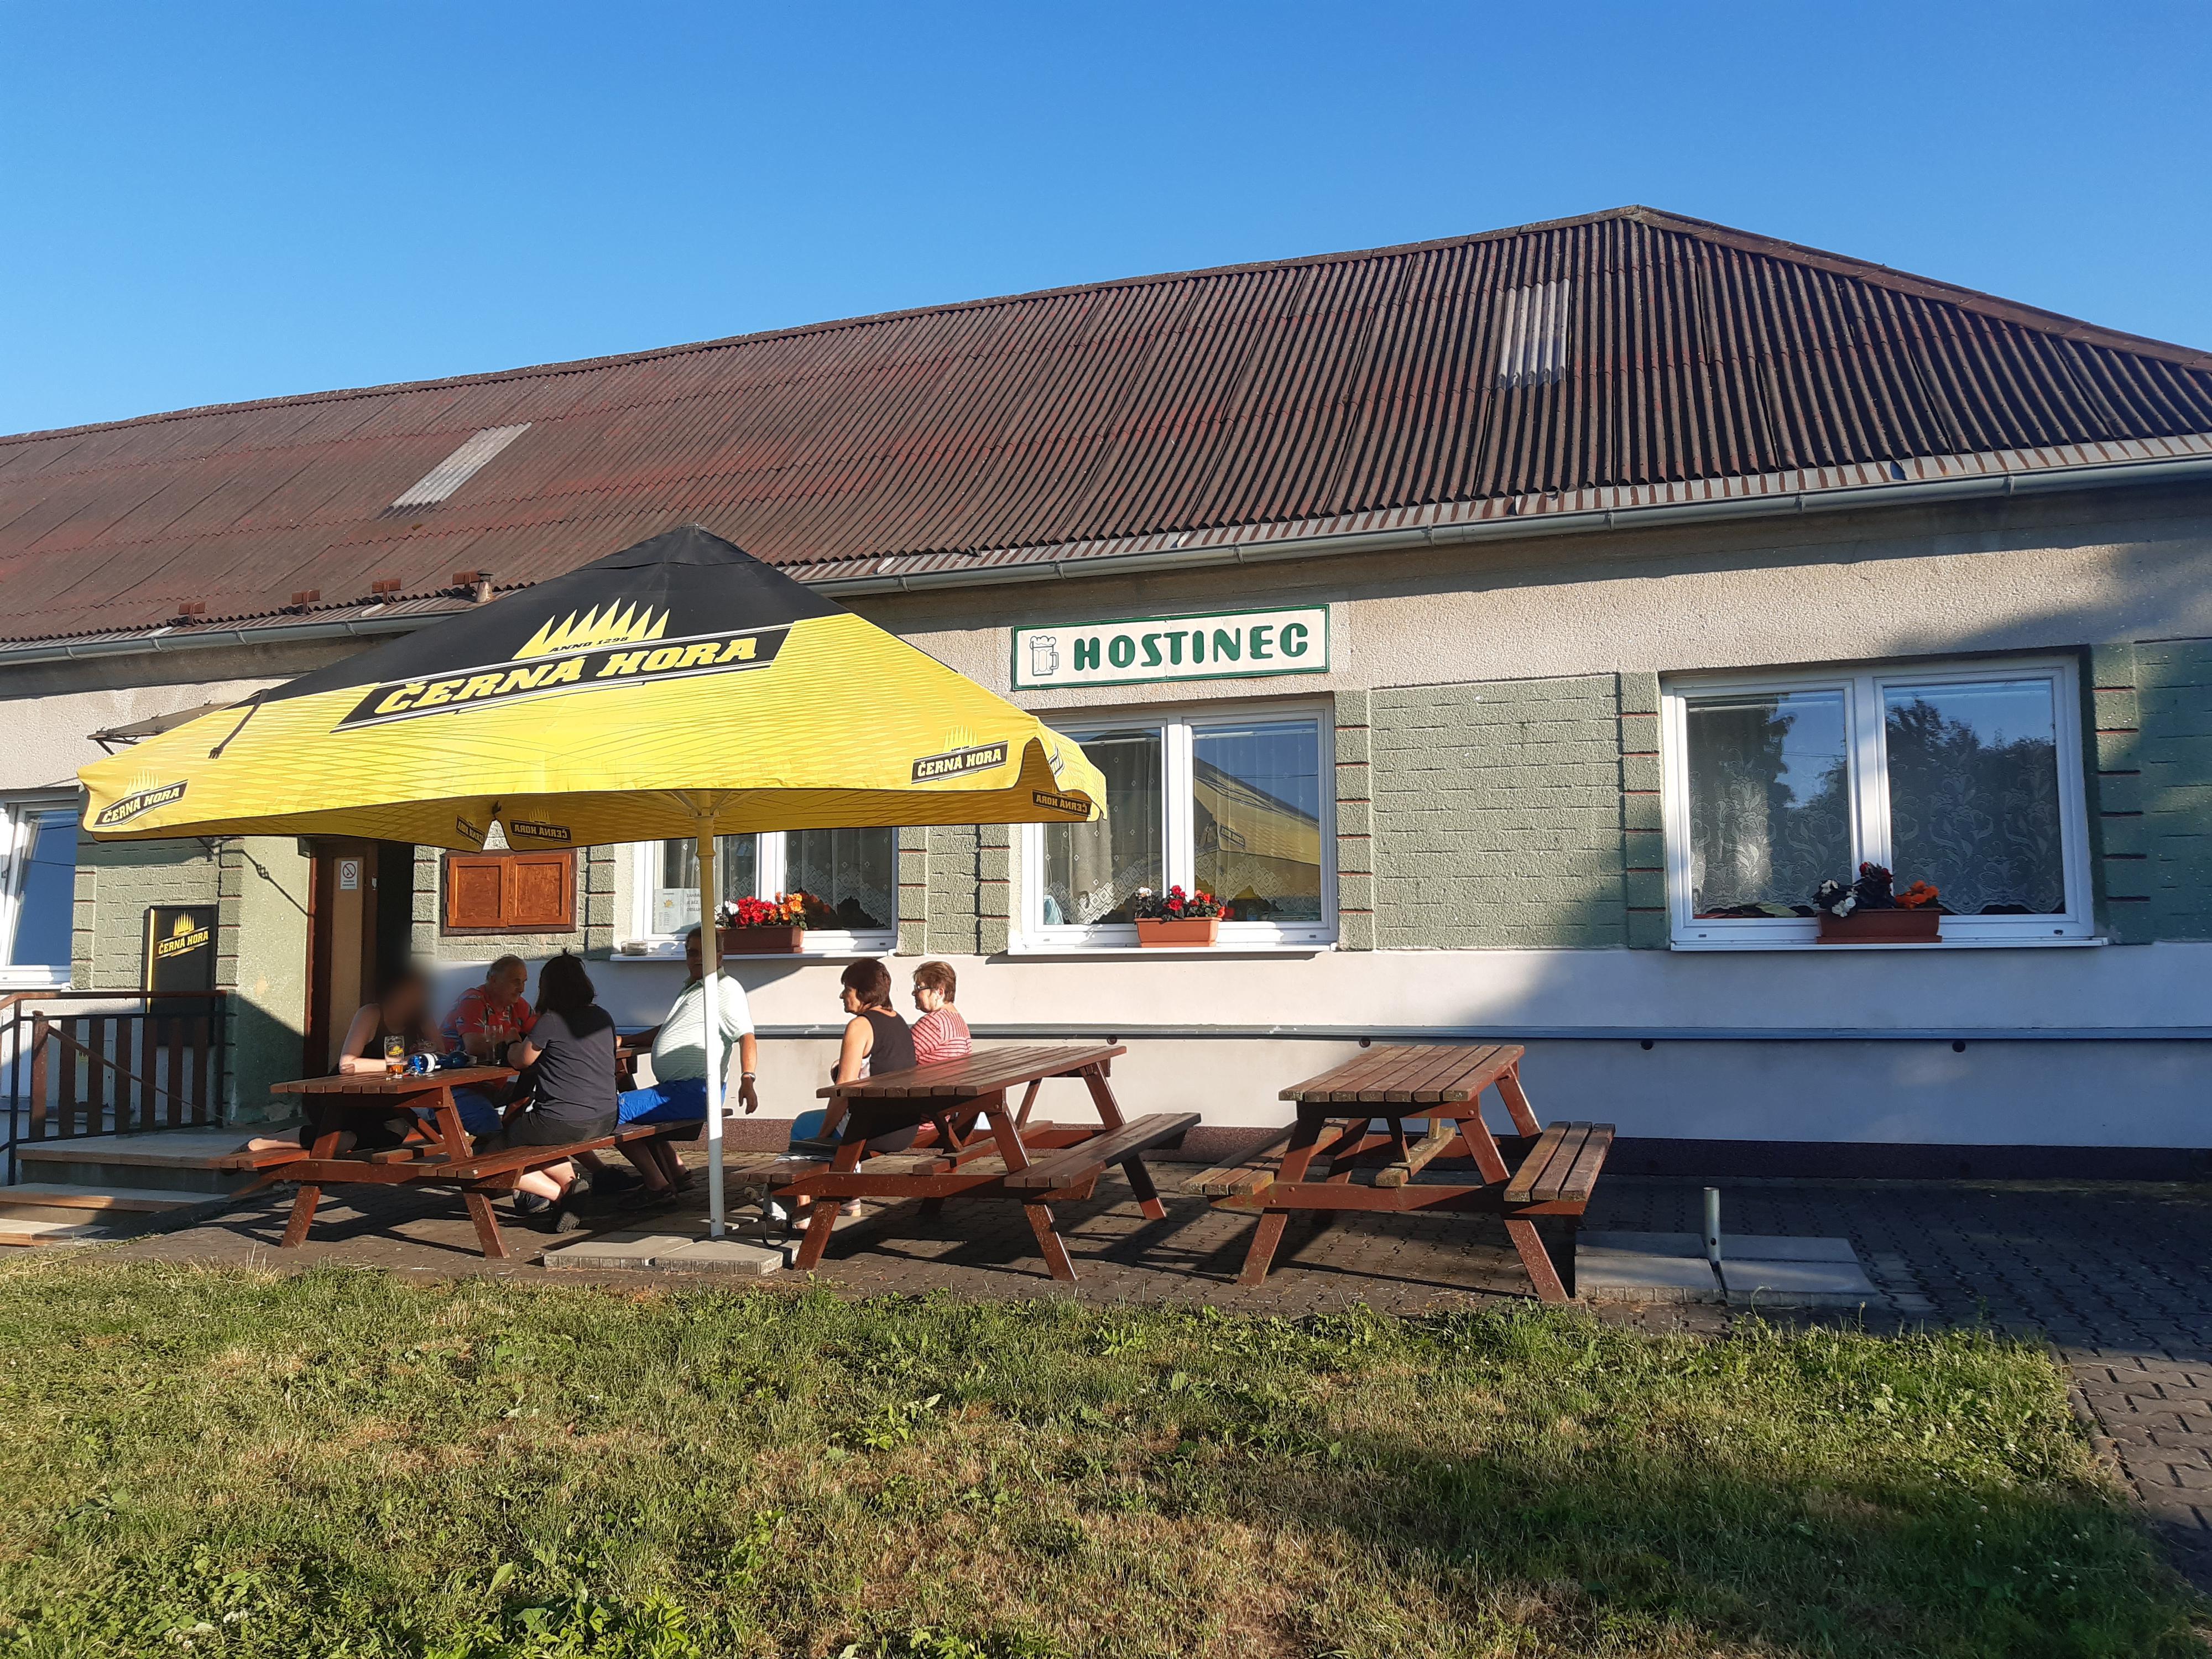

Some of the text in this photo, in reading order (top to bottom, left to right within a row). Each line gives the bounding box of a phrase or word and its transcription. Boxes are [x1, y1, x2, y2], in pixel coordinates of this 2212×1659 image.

[547, 637, 629, 653] ANNO 1298
[1073, 623, 1308, 671] HOSTINEC
[374, 637, 758, 714] ČERNÁ HORA
[917, 748, 1001, 777] ČERNÁ HORA
[102, 787, 180, 823] ČERNÁ HORA
[158, 931, 208, 954] ČERNÁ HORA
